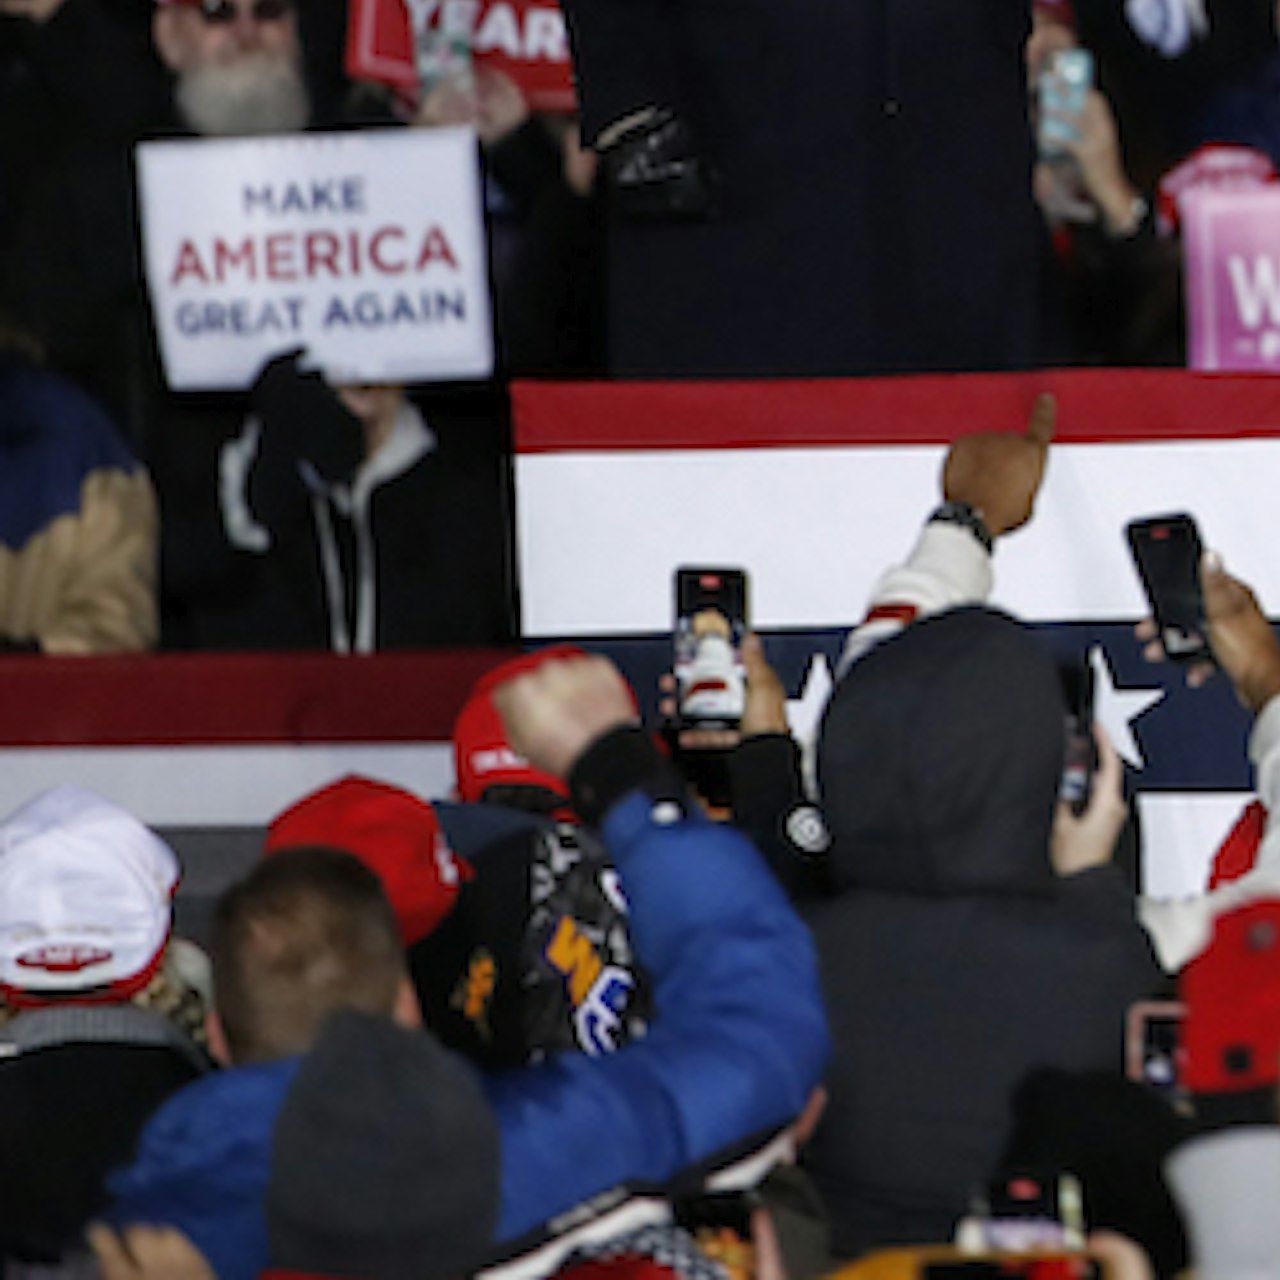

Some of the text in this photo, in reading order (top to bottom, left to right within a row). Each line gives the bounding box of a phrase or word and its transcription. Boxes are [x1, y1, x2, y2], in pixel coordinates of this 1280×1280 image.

[242, 173, 370, 217] MAKE
[169, 222, 459, 286] AMERICA
[175, 286, 468, 338] GREAT AGAIN
